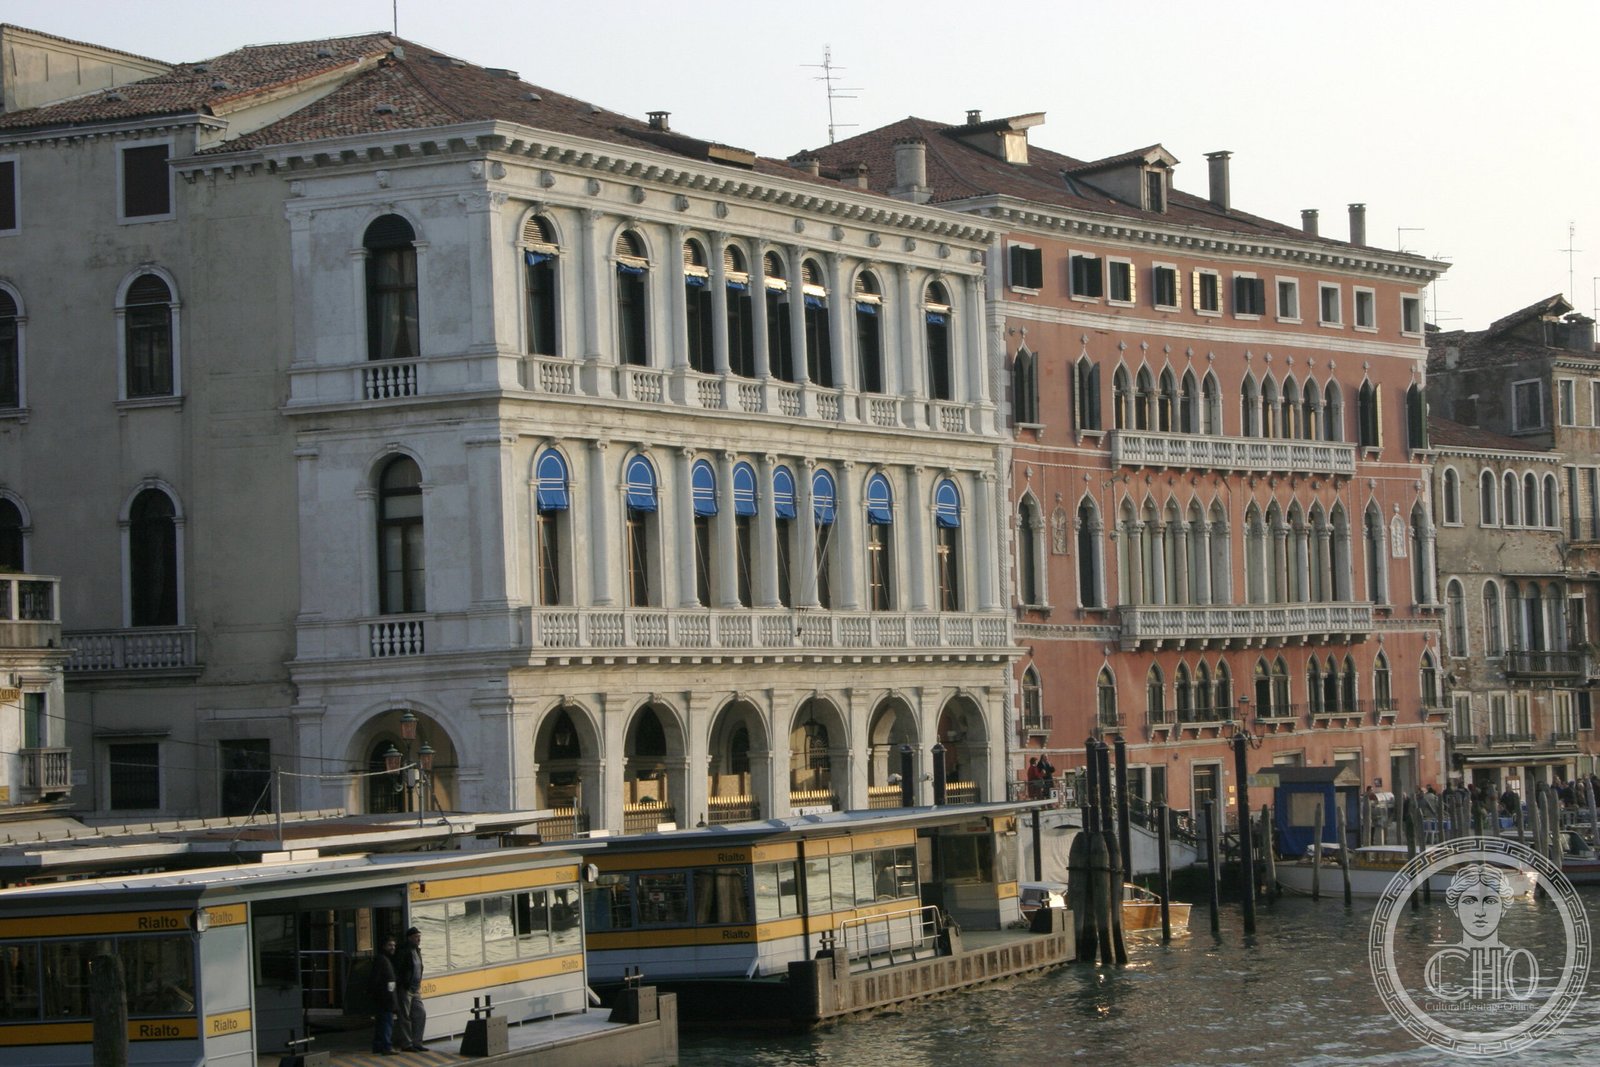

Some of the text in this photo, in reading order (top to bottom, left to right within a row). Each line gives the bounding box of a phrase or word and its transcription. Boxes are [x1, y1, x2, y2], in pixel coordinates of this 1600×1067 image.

[717, 853, 746, 862] Rialto
[555, 871, 574, 881] Rialto
[137, 916, 179, 929] Rialto
[209, 912, 234, 924] Rialto
[722, 930, 751, 939] Rialto
[561, 960, 579, 971] Rialto
[419, 983, 437, 994] ialto
[139, 1024, 181, 1037] Rialto
[213, 1019, 238, 1033] Rialto
